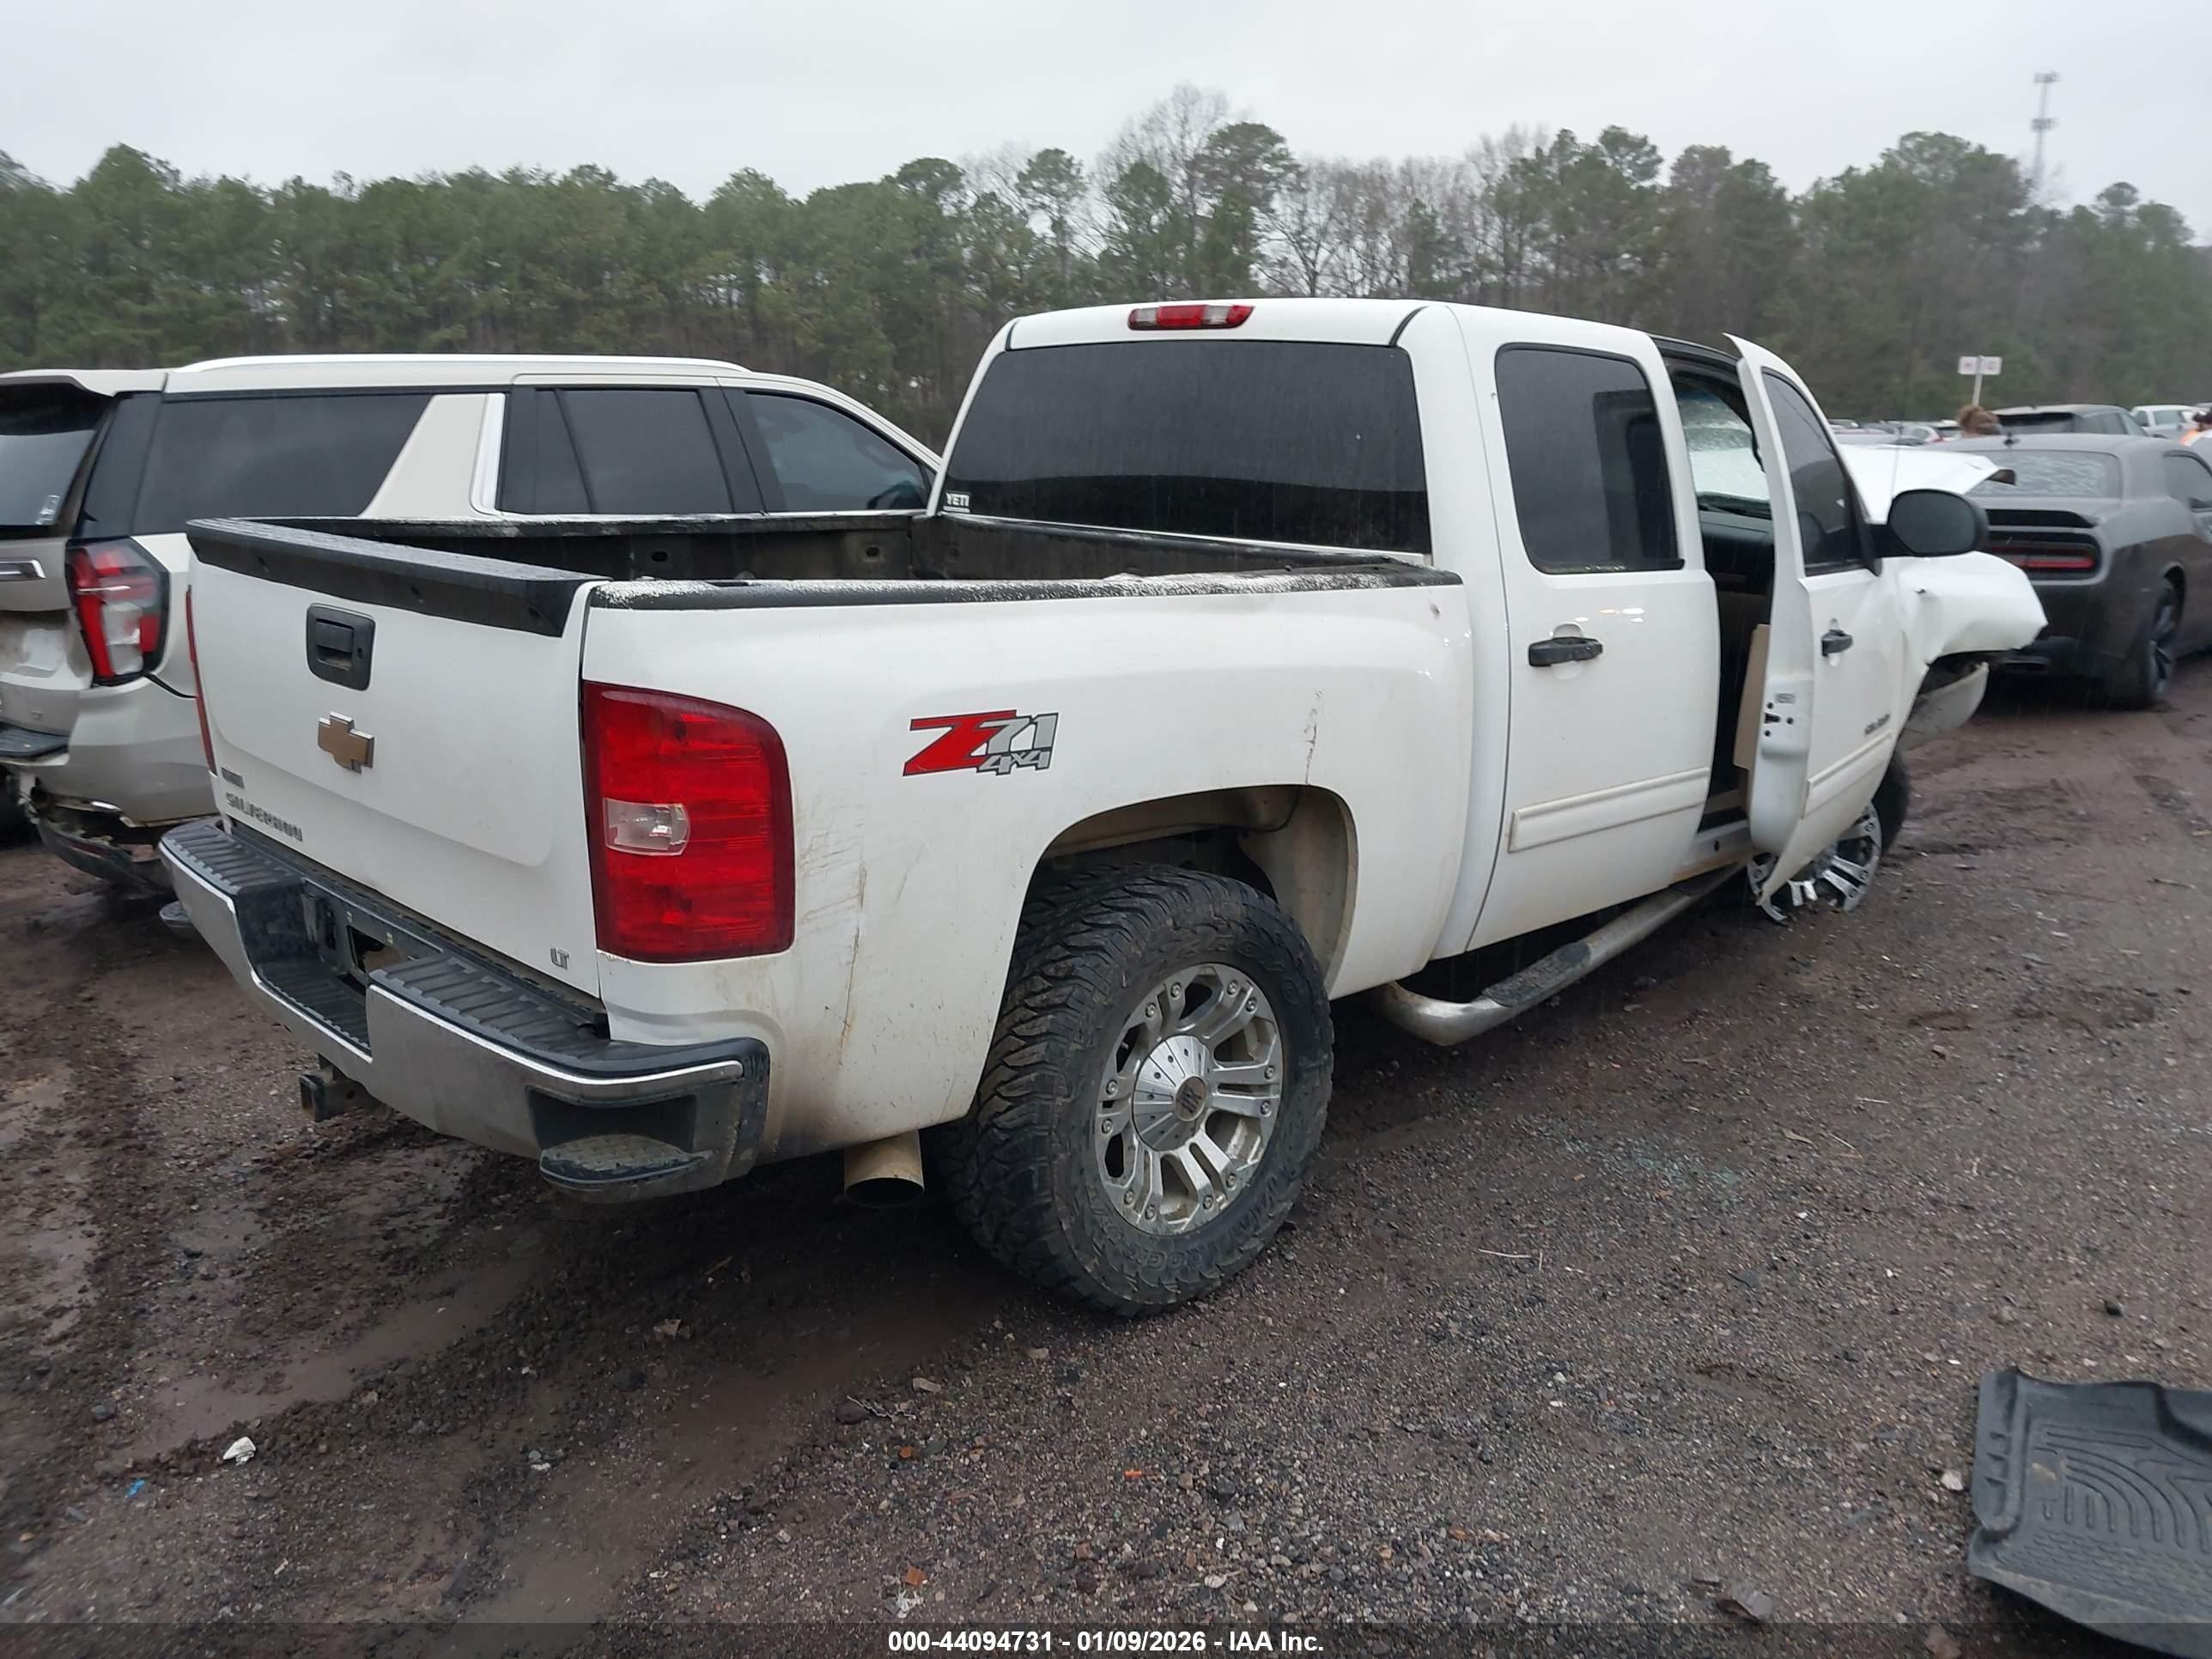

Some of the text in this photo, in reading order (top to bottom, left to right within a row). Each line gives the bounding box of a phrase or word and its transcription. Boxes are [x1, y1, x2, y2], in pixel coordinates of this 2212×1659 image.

[945, 492, 970, 507] YETI
[902, 709, 1059, 776] Z71
[550, 947, 570, 969] LT
